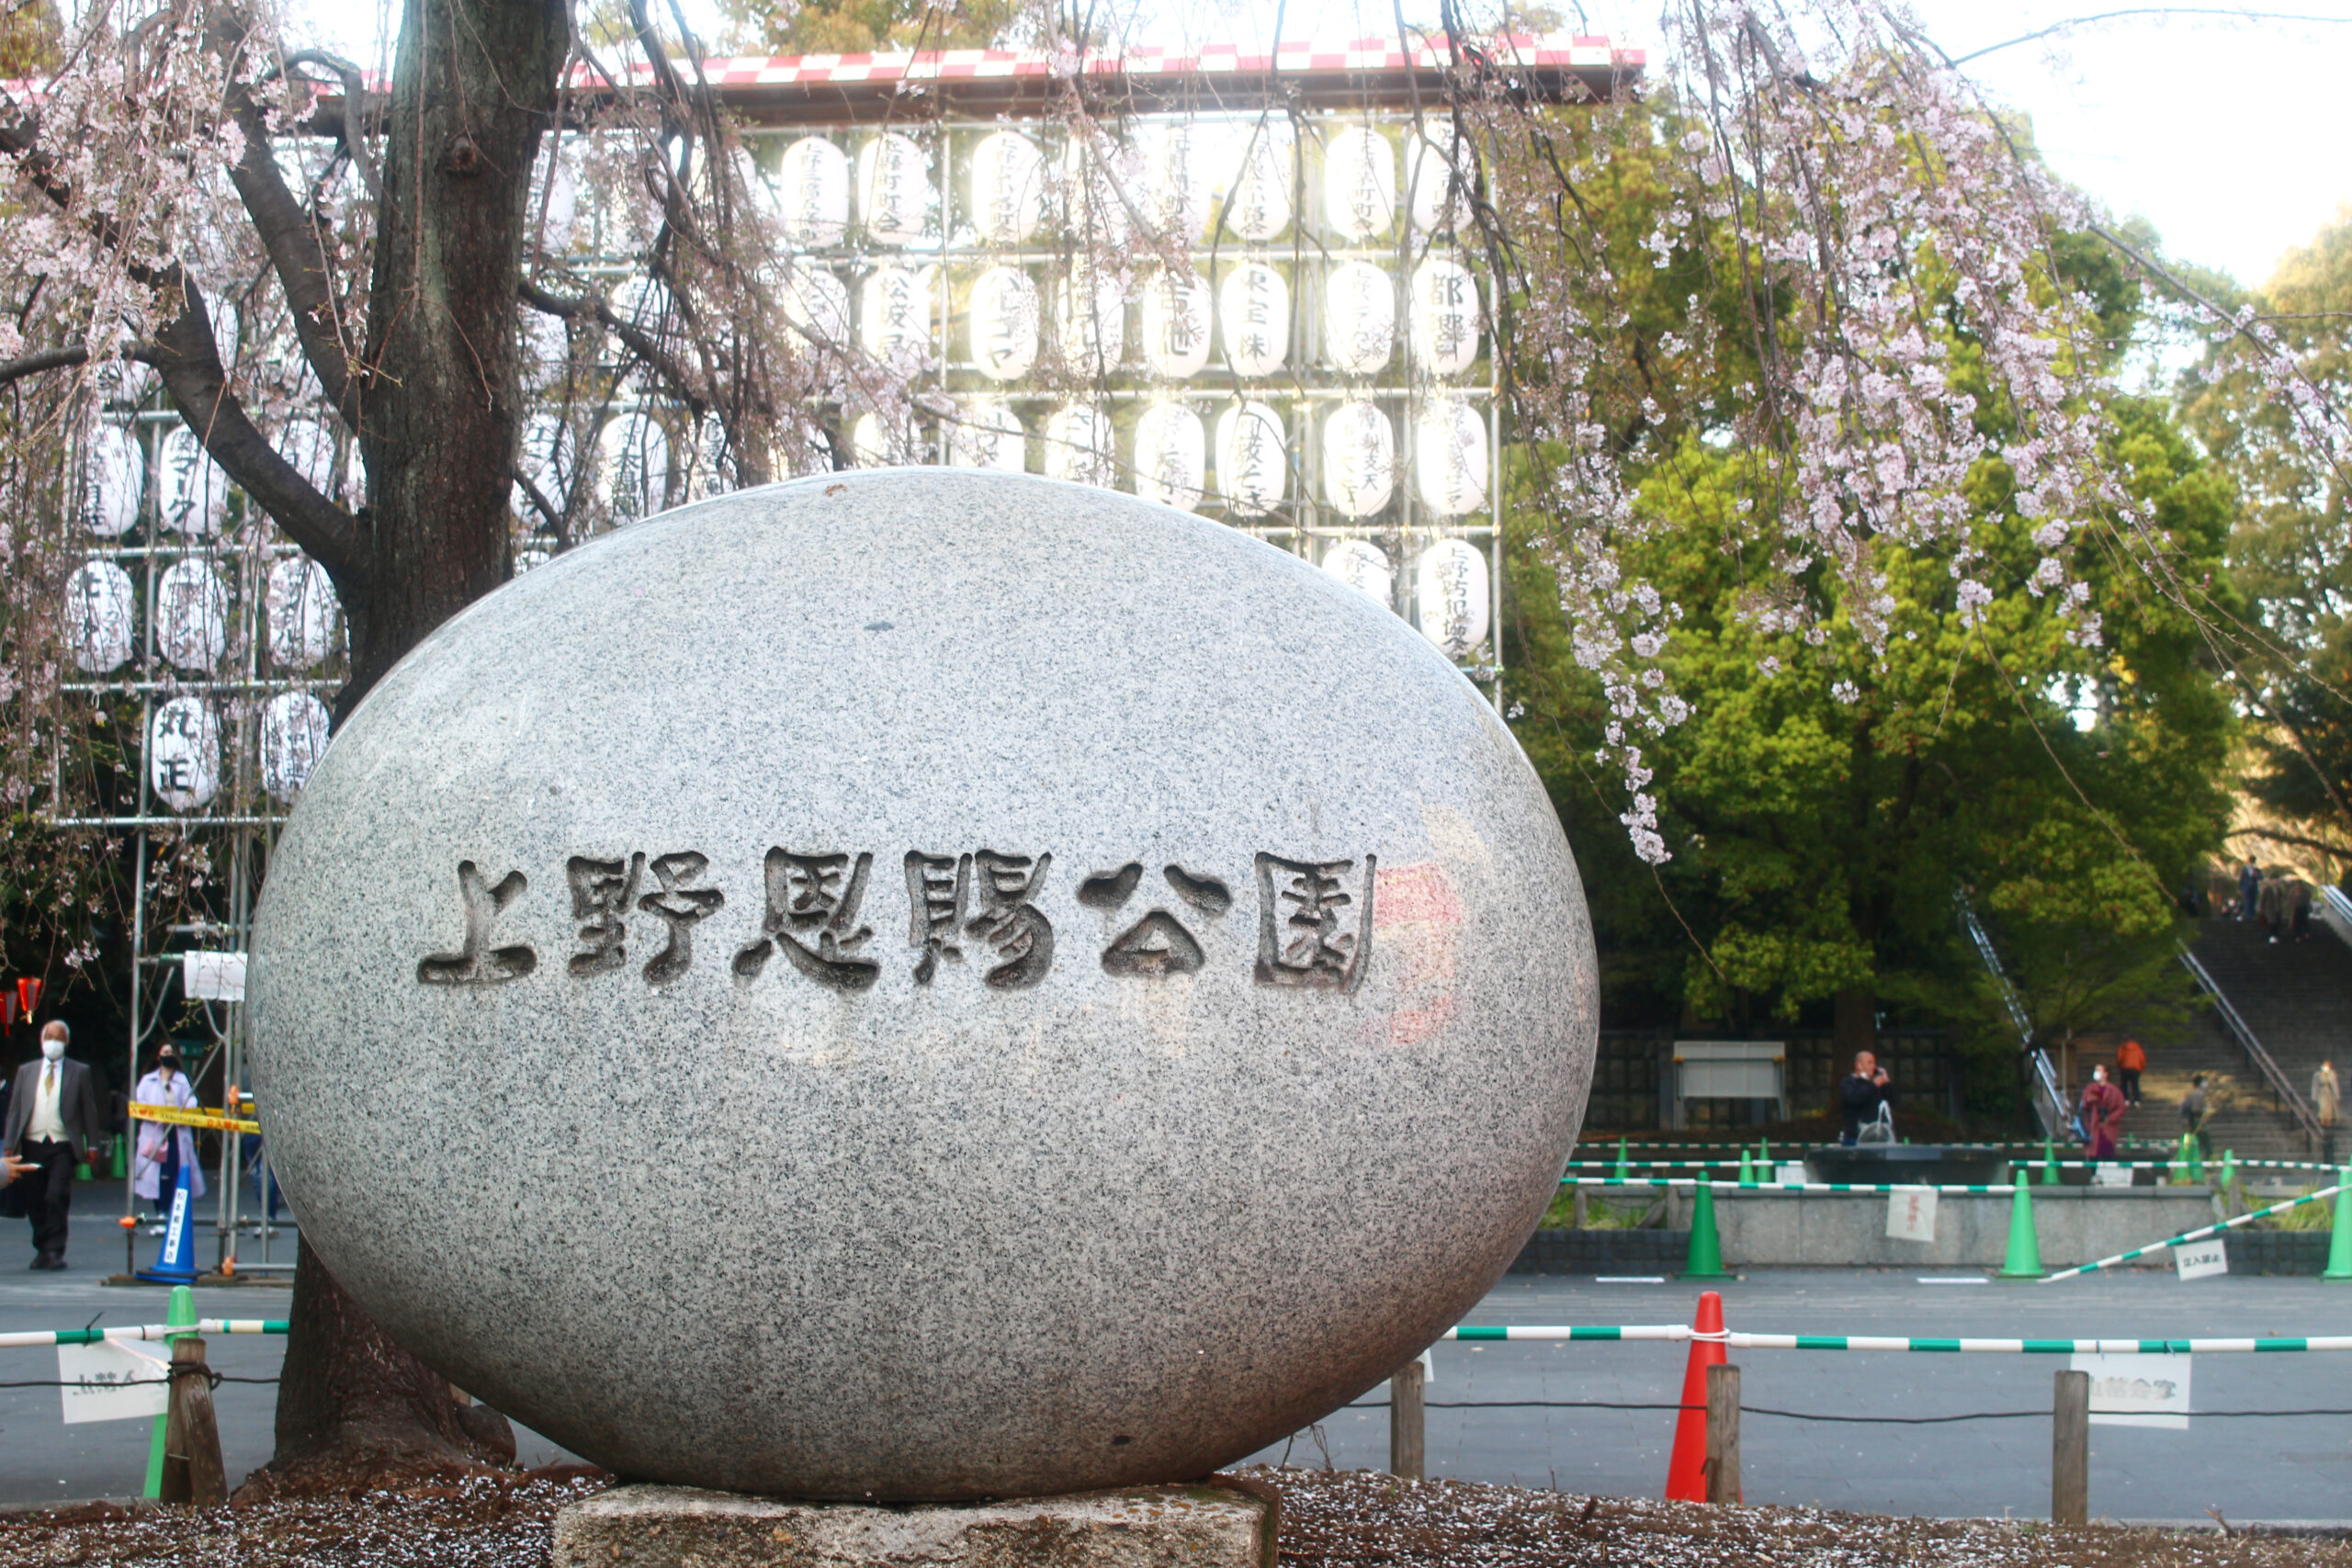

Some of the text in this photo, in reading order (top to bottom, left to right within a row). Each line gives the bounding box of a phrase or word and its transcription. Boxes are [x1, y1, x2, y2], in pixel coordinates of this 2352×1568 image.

[416, 845, 1380, 995] 上野恩賜公園
